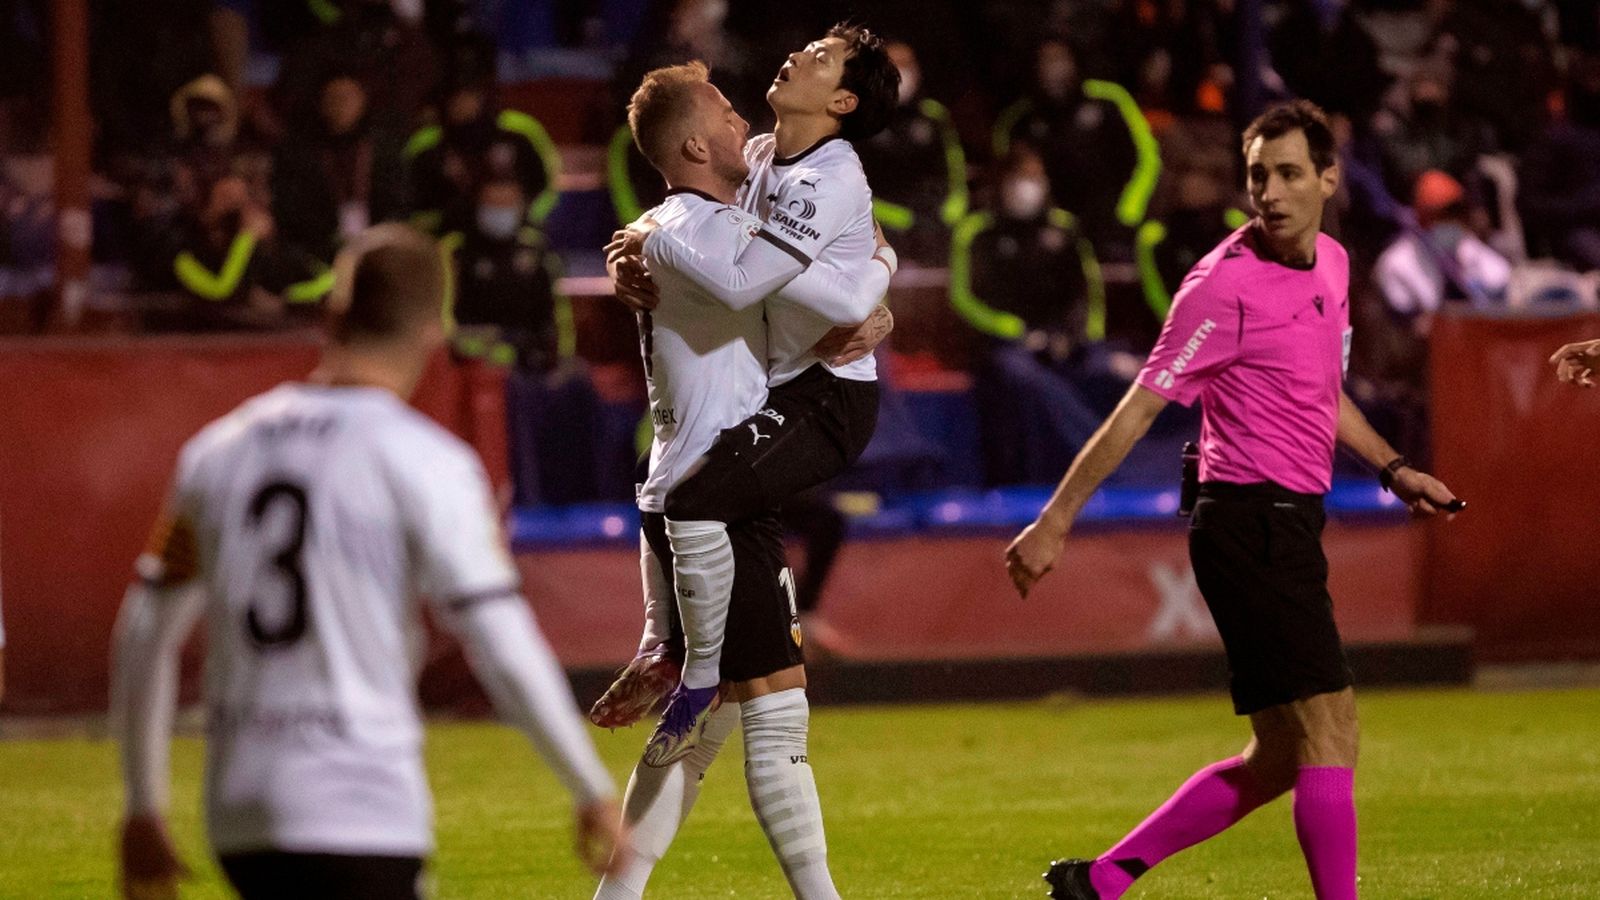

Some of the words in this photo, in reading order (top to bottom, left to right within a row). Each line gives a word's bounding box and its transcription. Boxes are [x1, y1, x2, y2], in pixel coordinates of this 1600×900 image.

[773, 213, 821, 240] SAILUN
[780, 225, 804, 241] TYRE
[244, 478, 309, 647] 3
